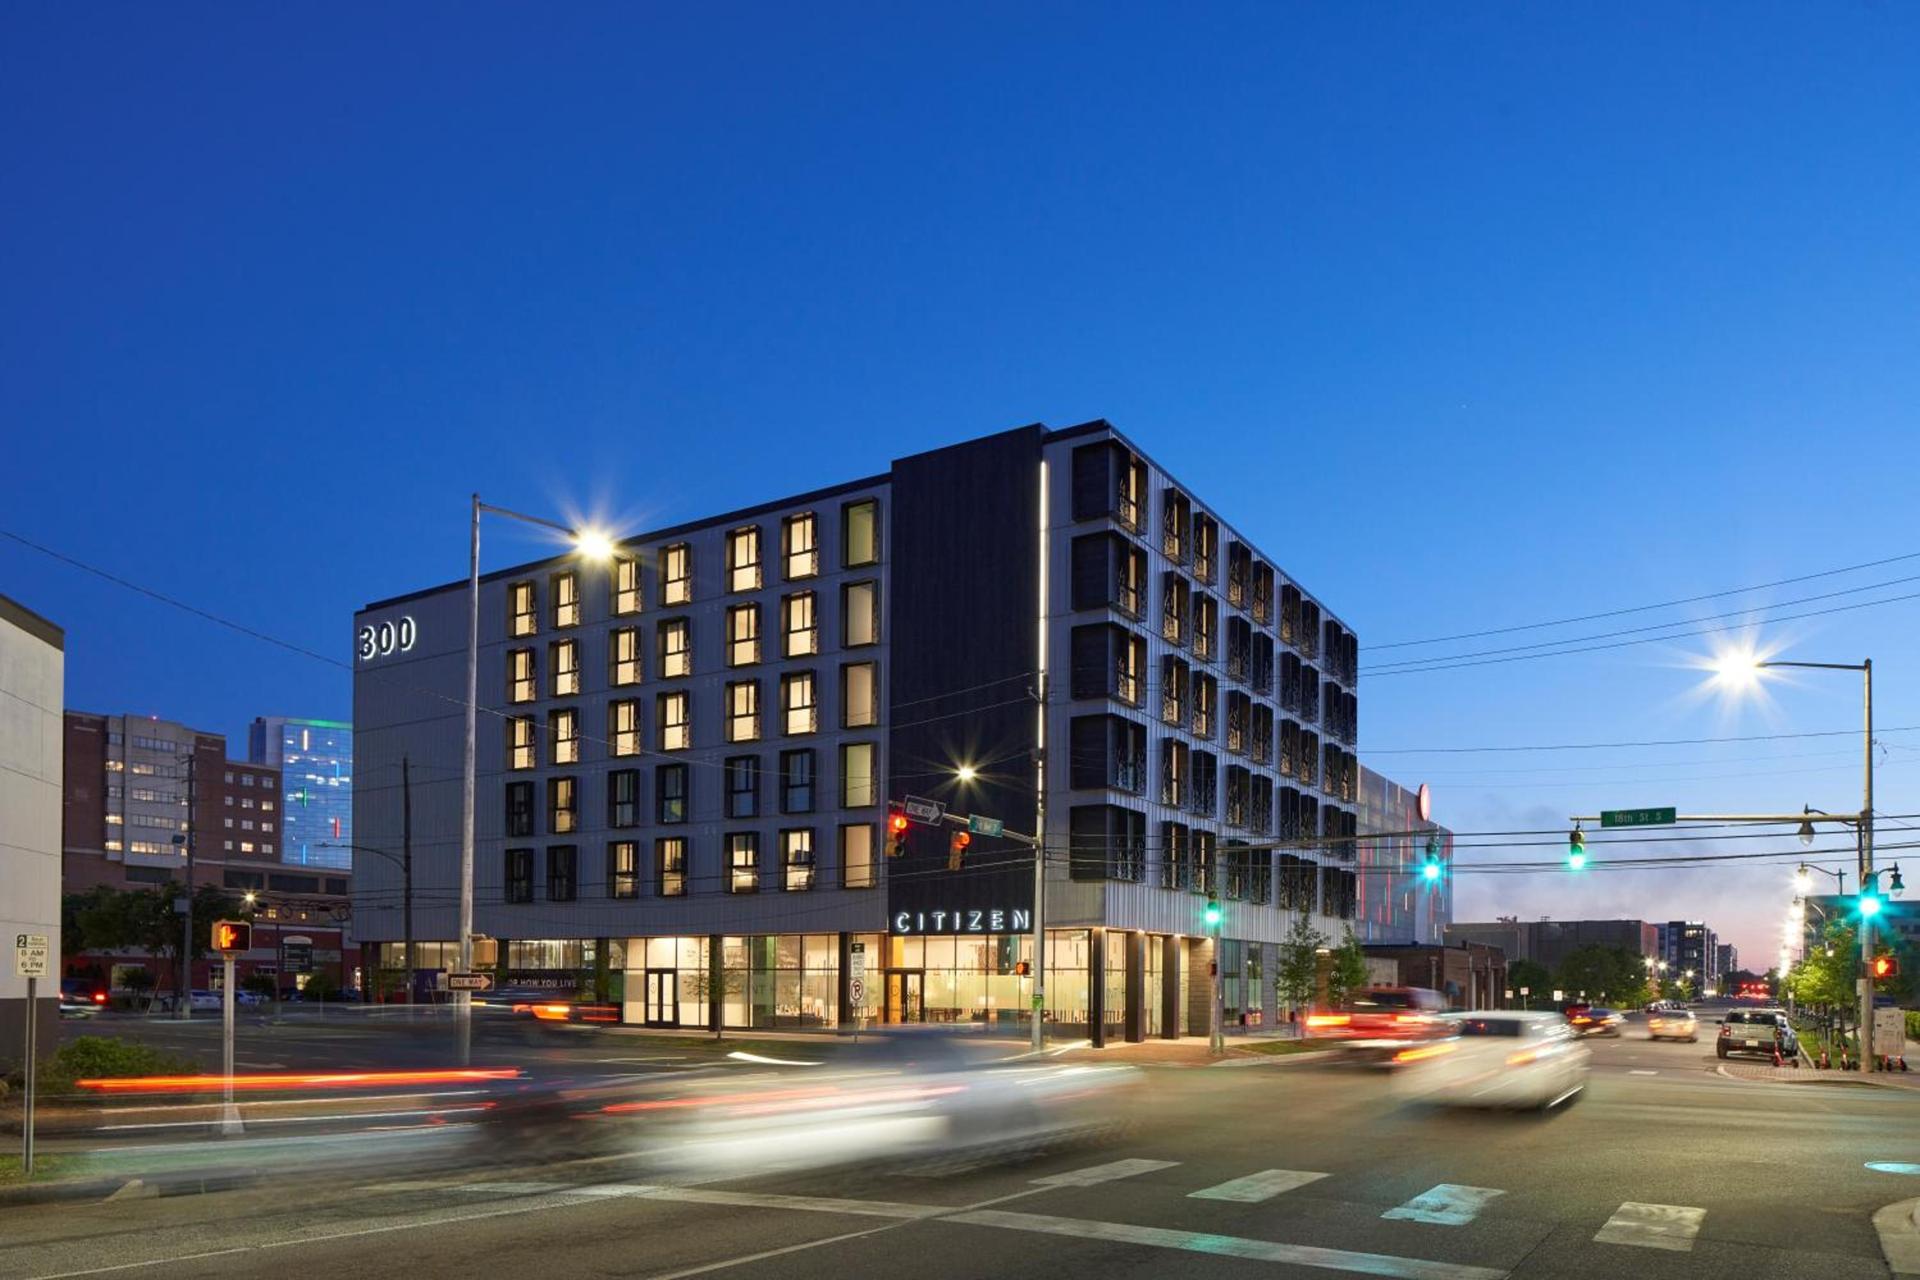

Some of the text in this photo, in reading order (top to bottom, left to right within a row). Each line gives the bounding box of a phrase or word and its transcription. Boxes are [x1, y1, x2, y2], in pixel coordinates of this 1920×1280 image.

[360, 616, 416, 660] 300
[896, 909, 1030, 933] CITIZEN
[18, 936, 25, 946] 2
[452, 978, 482, 988] ONE WAY
[520, 978, 539, 988] HOW
[541, 978, 558, 988] YOU
[560, 978, 577, 988] LIVE
